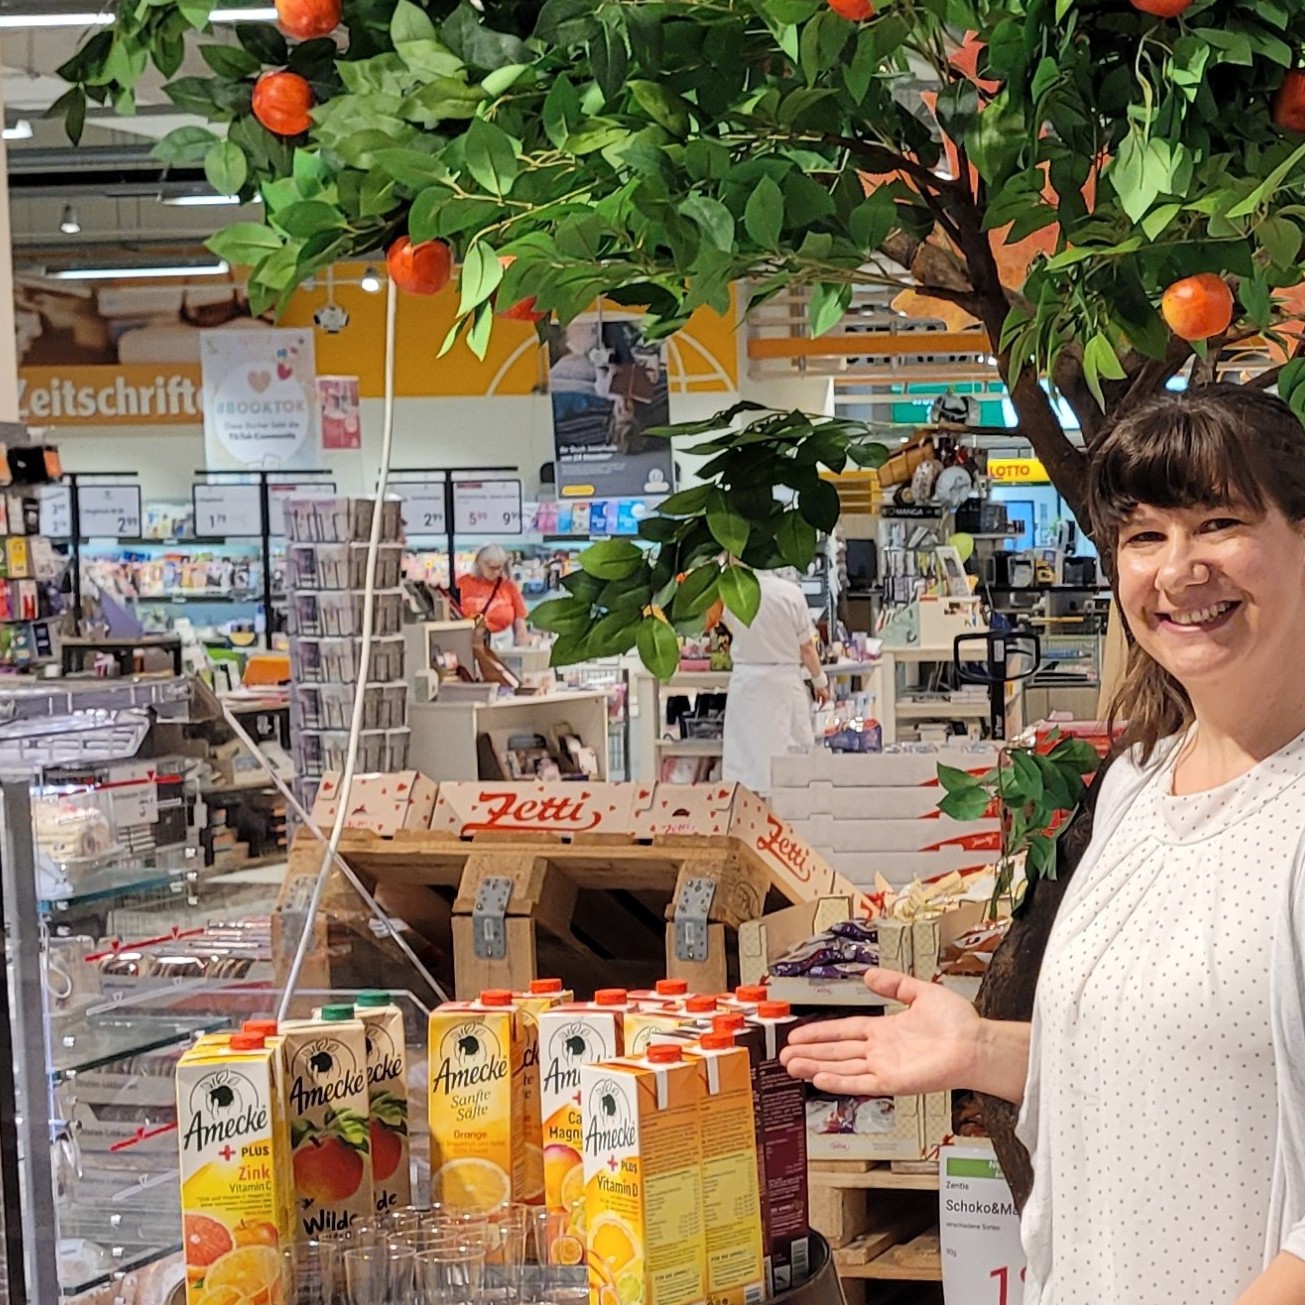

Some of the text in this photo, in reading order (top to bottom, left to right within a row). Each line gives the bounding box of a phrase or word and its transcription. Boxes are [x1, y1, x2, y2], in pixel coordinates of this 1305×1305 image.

[989, 464, 1030, 479] LOTTO
[366, 1055, 403, 1085] ecke
[433, 1054, 508, 1096] Amecke
[290, 1069, 366, 1116] Amecke
[450, 1089, 491, 1111] Sanfte
[456, 1104, 489, 1122] Säfte
[184, 1103, 268, 1152] Amecke
[454, 1129, 488, 1140] Orange
[585, 1116, 636, 1157] Amecke
[241, 1145, 270, 1158] PLUS
[238, 1163, 270, 1181] Zink
[620, 1160, 638, 1174] PLUS
[229, 1181, 272, 1193] Vitamin C
[596, 1173, 639, 1197] Vitamin D
[945, 1180, 970, 1191] Zentis
[945, 1198, 1021, 1217] Schoko&Ma
